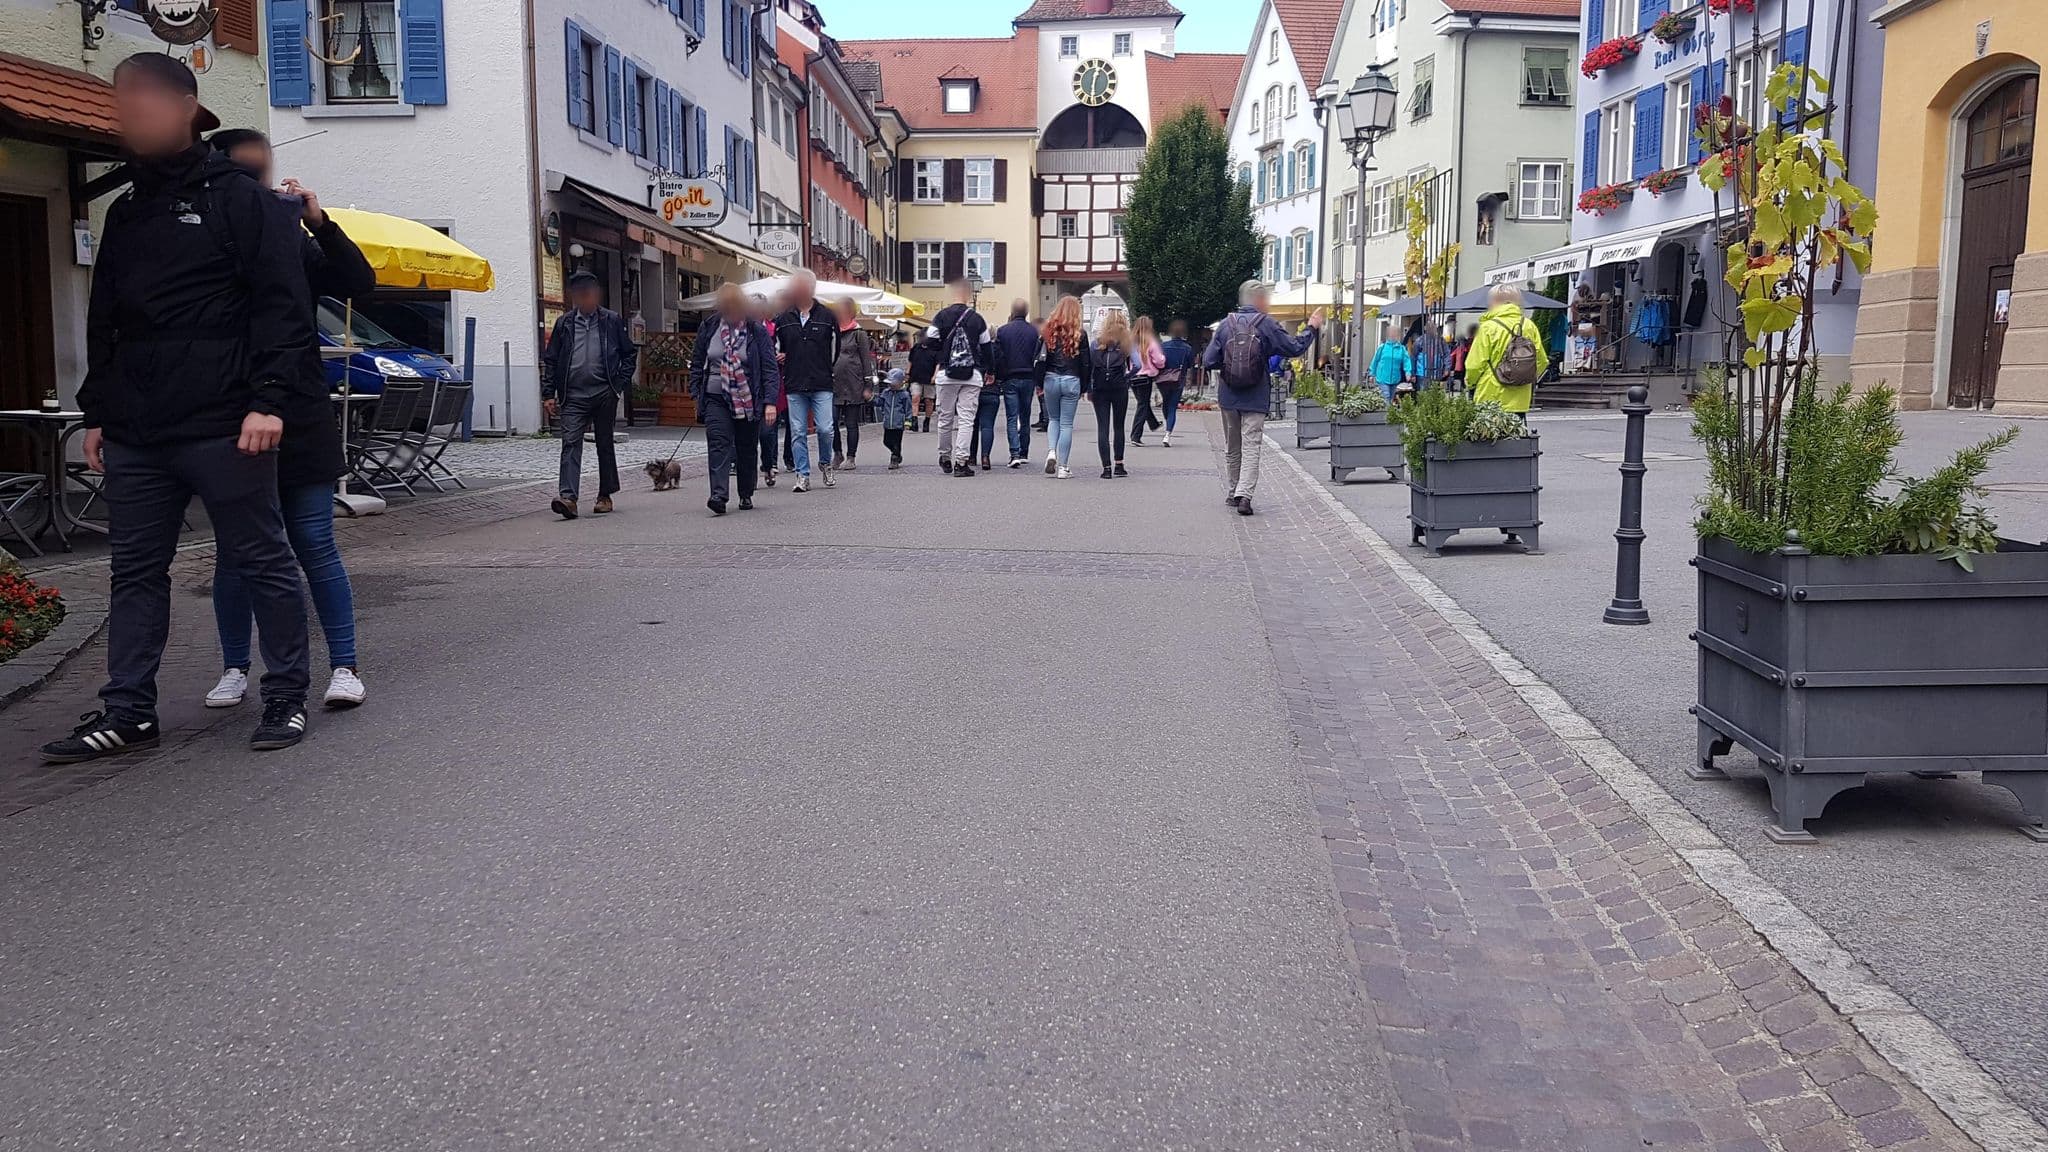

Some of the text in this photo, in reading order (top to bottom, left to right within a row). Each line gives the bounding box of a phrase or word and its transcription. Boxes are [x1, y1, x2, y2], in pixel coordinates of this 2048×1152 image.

[659, 182, 683, 191] Bistro
[659, 190, 674, 198] Bar
[761, 241, 797, 251] Tor Grill
[1600, 248, 1622, 262] SPORT
[1542, 258, 1578, 274] SPORT PFAU
[1507, 269, 1521, 281] PFAU
